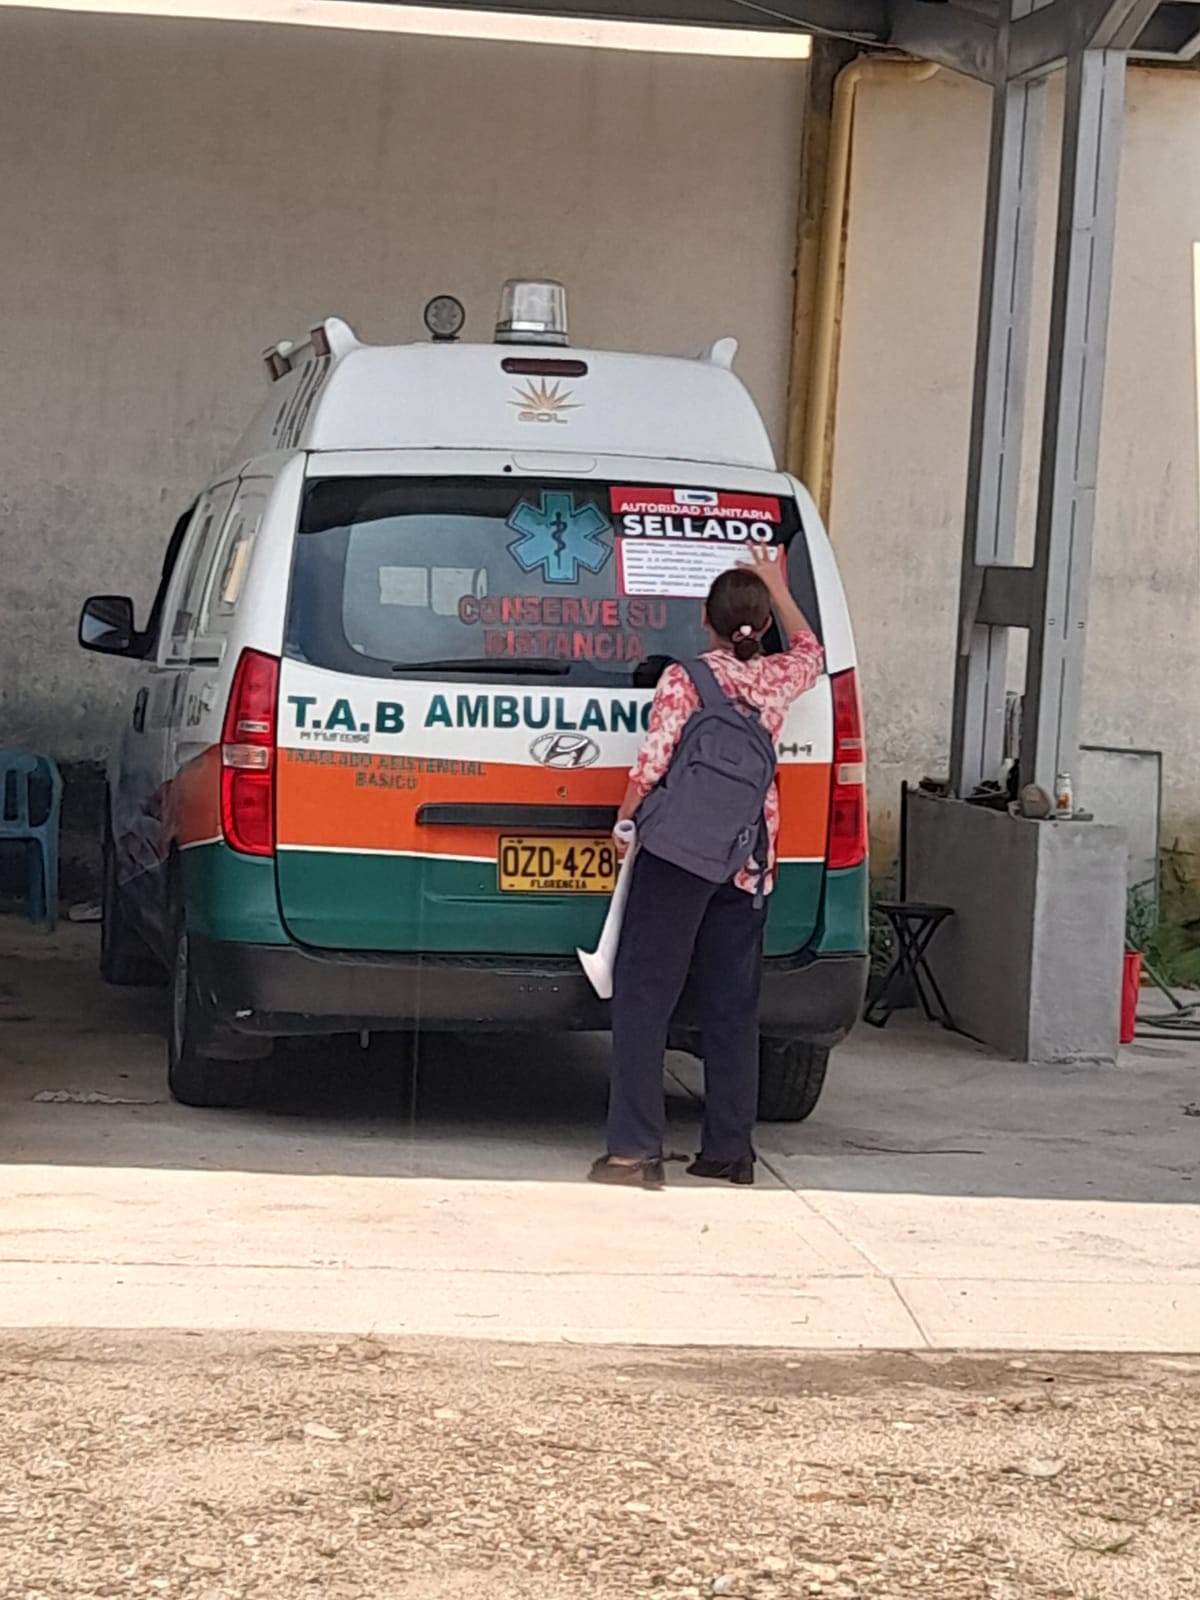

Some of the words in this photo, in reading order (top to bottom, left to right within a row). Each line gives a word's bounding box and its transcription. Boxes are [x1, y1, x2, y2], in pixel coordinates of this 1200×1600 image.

[620, 502, 701, 515] AUTORIDAD
[703, 507, 773, 521] SANITARIA
[622, 514, 773, 543] SELLADO
[458, 594, 621, 627] CONSERVE
[628, 598, 668, 629] SU
[484, 629, 645, 661] DISTANCIA
[287, 695, 404, 733] T.A.B
[355, 772, 417, 790] BASICO
